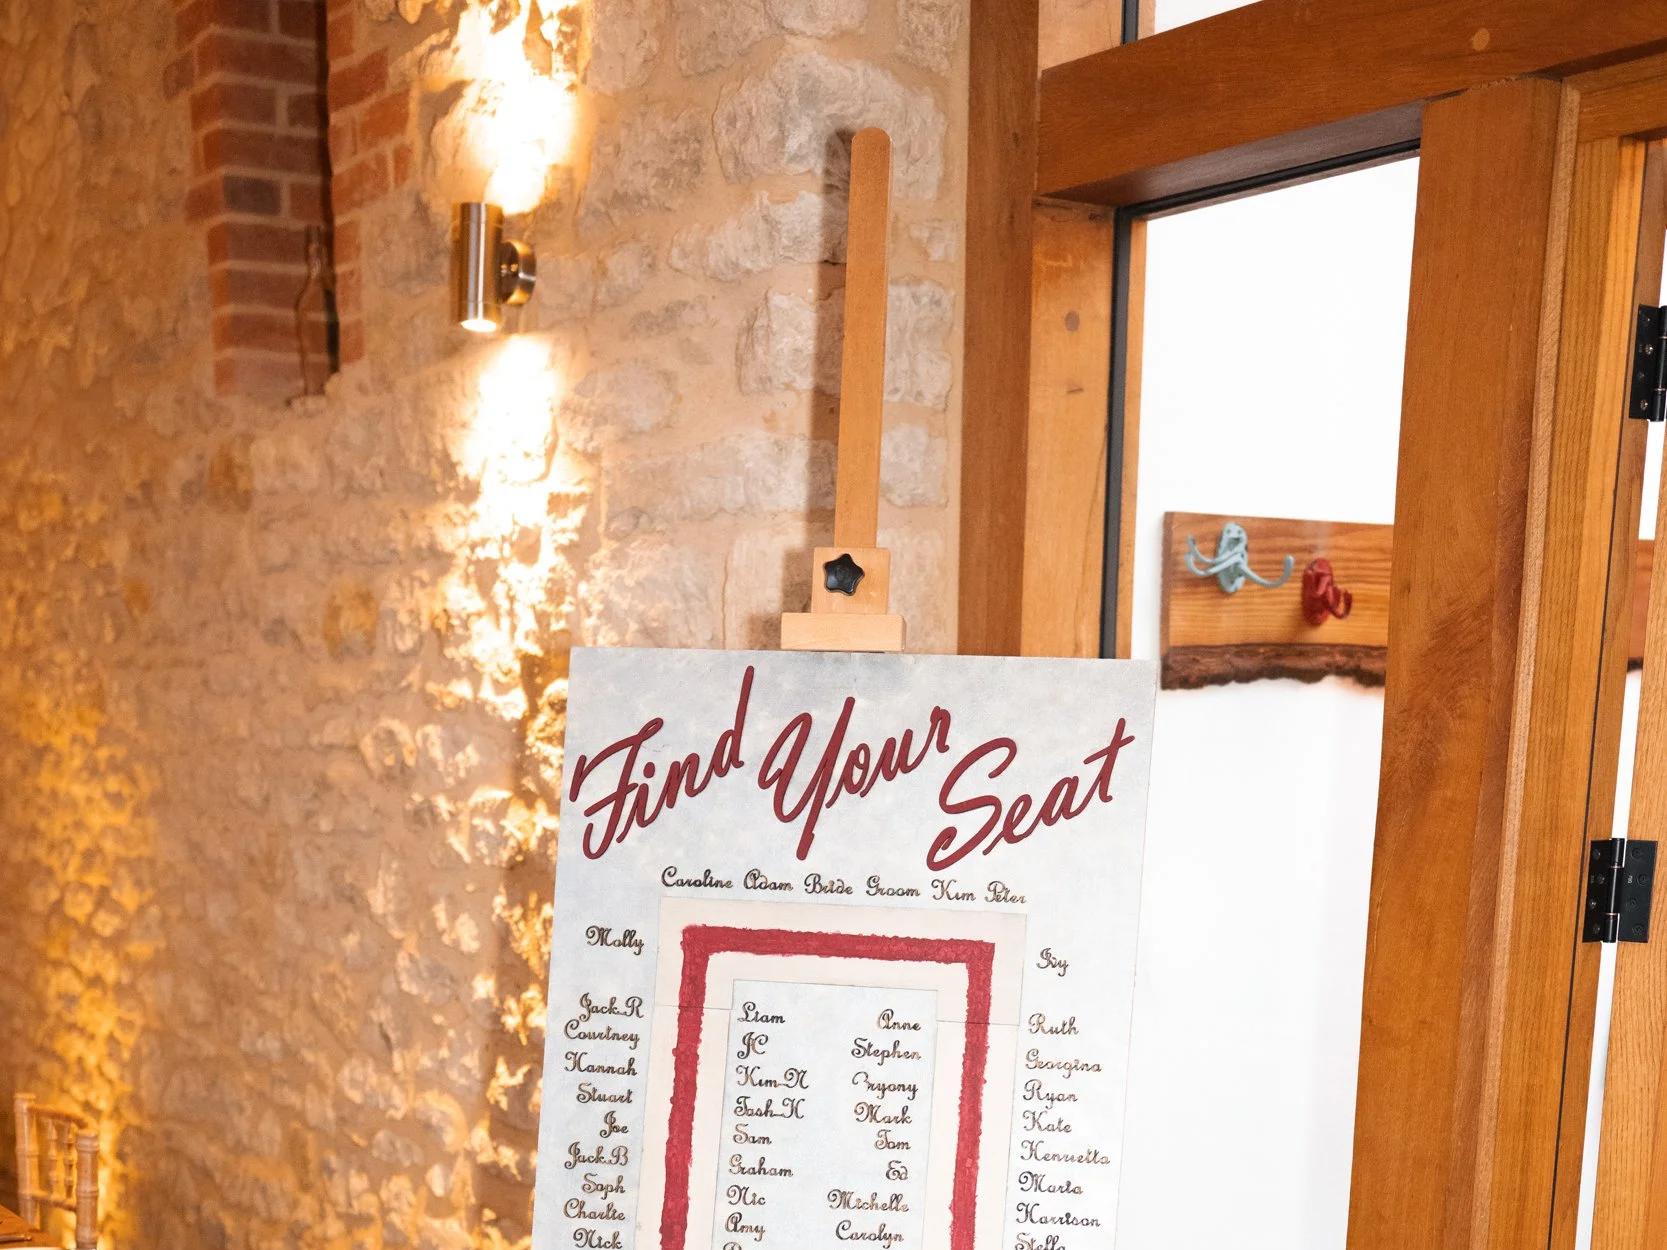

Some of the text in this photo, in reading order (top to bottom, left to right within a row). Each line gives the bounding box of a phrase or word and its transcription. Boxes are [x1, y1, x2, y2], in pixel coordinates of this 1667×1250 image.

[569, 666, 1135, 871] Find Your Seat
[661, 866, 1026, 904] Caroline Adam Bride Groom Kim Peter
[586, 926, 644, 955] Molly
[1036, 948, 1068, 977] Ivy
[738, 1002, 785, 1024] Liam
[877, 1009, 921, 1032] Anne
[1028, 1014, 1079, 1036] Ruth
[564, 1019, 639, 1050] Courtney
[737, 1032, 768, 1059] JC
[565, 1051, 637, 1075] Hannah
[851, 1038, 922, 1065] Stephen
[1026, 1049, 1102, 1079] Georgina
[576, 1083, 632, 1103] Stuart
[1023, 1079, 1078, 1110] Ryan
[600, 1110, 628, 1138] Joe
[854, 1102, 912, 1124] Mark
[1022, 1110, 1072, 1133] Kate
[733, 1124, 772, 1144] Sam
[875, 1130, 911, 1150] Tom
[1021, 1140, 1110, 1164] Henrietta
[729, 1155, 793, 1177] Graham
[886, 1161, 908, 1180] Ed
[582, 1174, 625, 1200] Soph
[726, 1185, 766, 1206] Nic
[1019, 1172, 1083, 1195] Maria
[564, 1199, 625, 1220] Charlie
[827, 1189, 909, 1212] Michelle
[725, 1213, 765, 1241] Amy
[1016, 1203, 1101, 1227] Harrison
[573, 1228, 622, 1249] Nick
[835, 1220, 903, 1248] Carolyn
